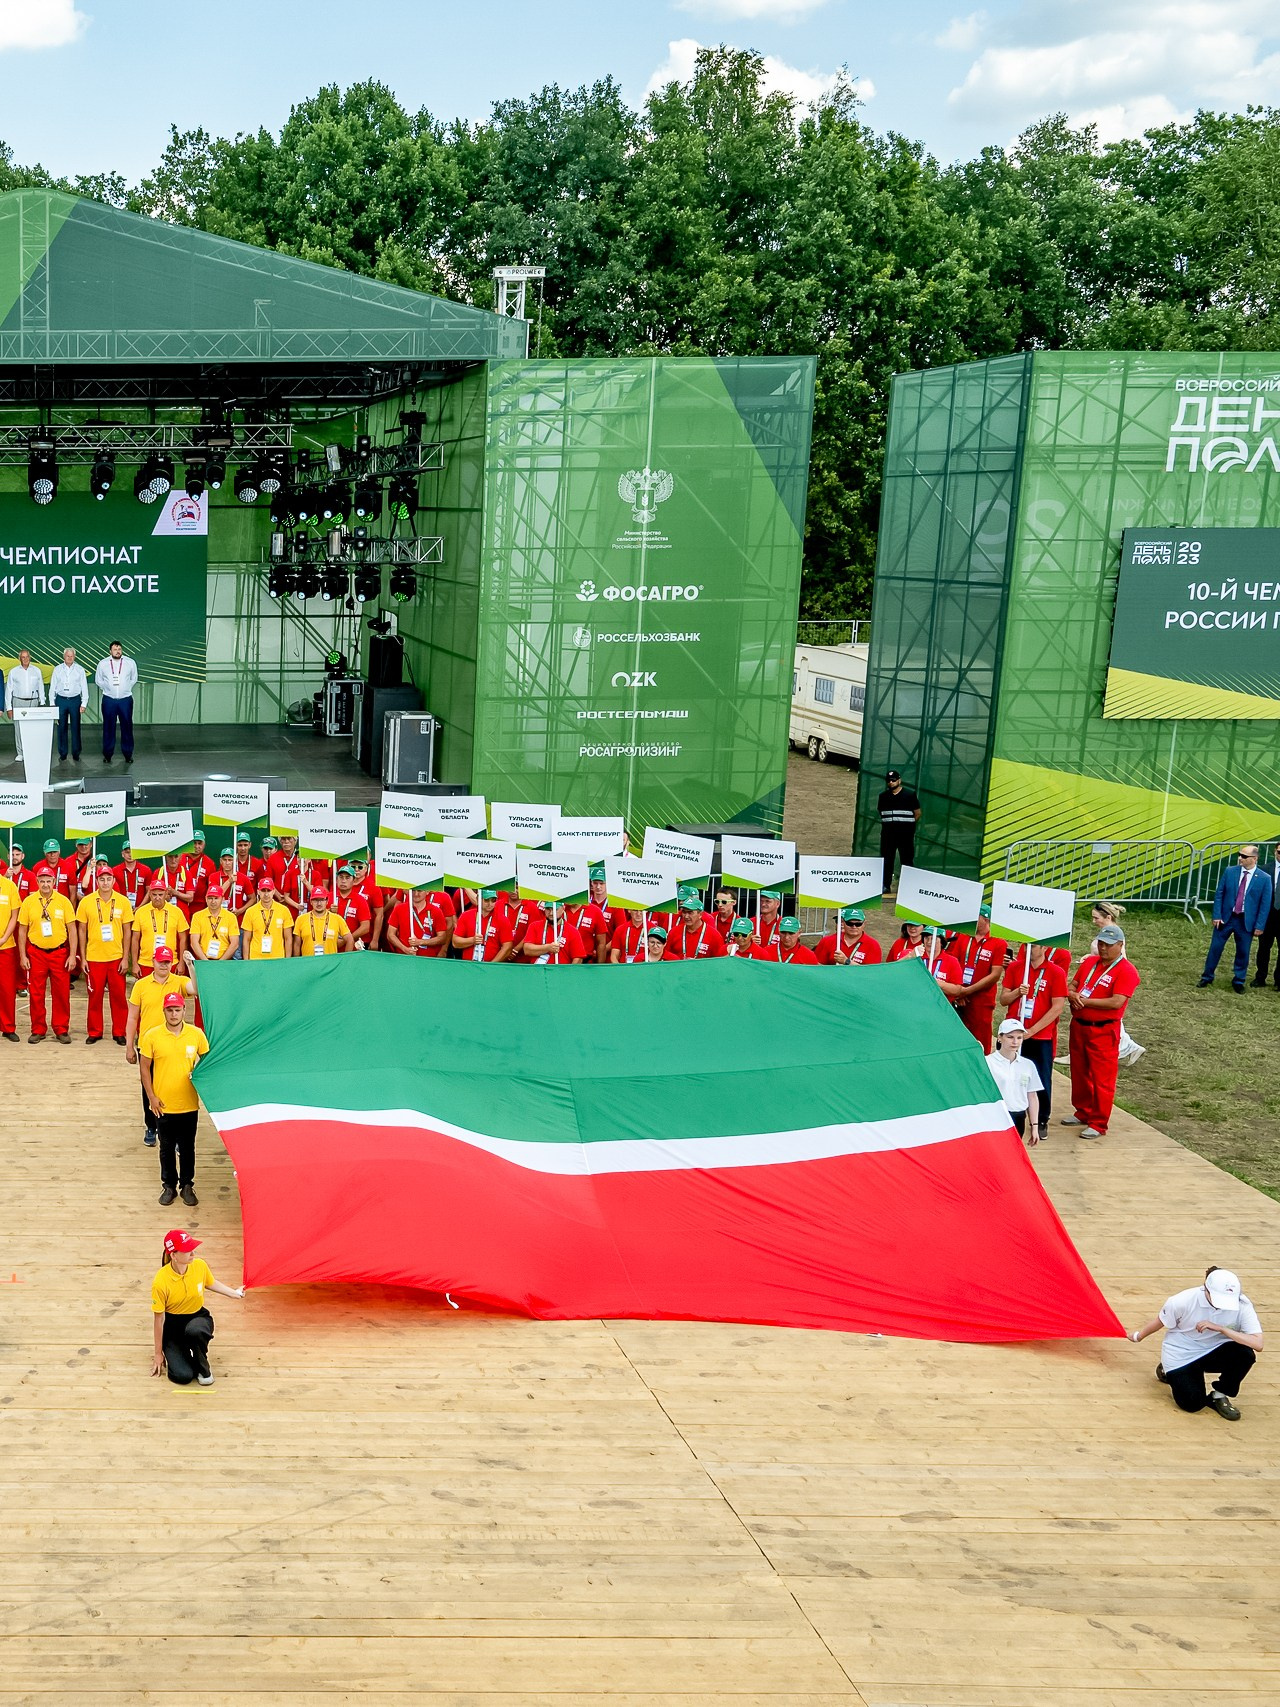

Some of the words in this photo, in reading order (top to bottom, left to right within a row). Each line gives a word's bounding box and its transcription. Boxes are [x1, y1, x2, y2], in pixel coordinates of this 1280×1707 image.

[1133, 546, 1172, 555] ДЕНЬ
[1178, 542, 1202, 553] 20
[0, 546, 142, 565] ЧЕМПИОНАТ
[1132, 555, 1171, 564] ПОЛЯ
[1177, 554, 1200, 564] 23
[32, 575, 66, 594] ПО
[72, 574, 160, 594] ПАХОТЕ
[1187, 578, 1238, 600] 10-Й
[1165, 611, 1267, 629] РОССИИ
[597, 633, 700, 643] РОССЕЛЬХОЗБАНК
[577, 710, 688, 719] РОСТСЕЛЬМАШ
[580, 746, 682, 757] РОСАГРОЛИЗИНГ
[141, 823, 180, 832] САМАРСКАЯ
[656, 842, 700, 856] УДМУРТСКАЯ
[387, 851, 431, 860] РЕСПУБЛИКА
[456, 851, 503, 859] РЕСПУБЛИКА
[655, 849, 699, 863] РЕСПУБЛИКА
[732, 850, 784, 860] УЛЬЯНОВСКАЯ
[382, 858, 436, 867] БАШКОРТОСТАН
[529, 864, 575, 872] РОСТОВСКАЯ
[617, 870, 663, 879] РЕСПУБЛИКА
[919, 889, 960, 903] БЕЛАРУСЬ
[1009, 903, 1054, 915] КАЗАХСТАН
